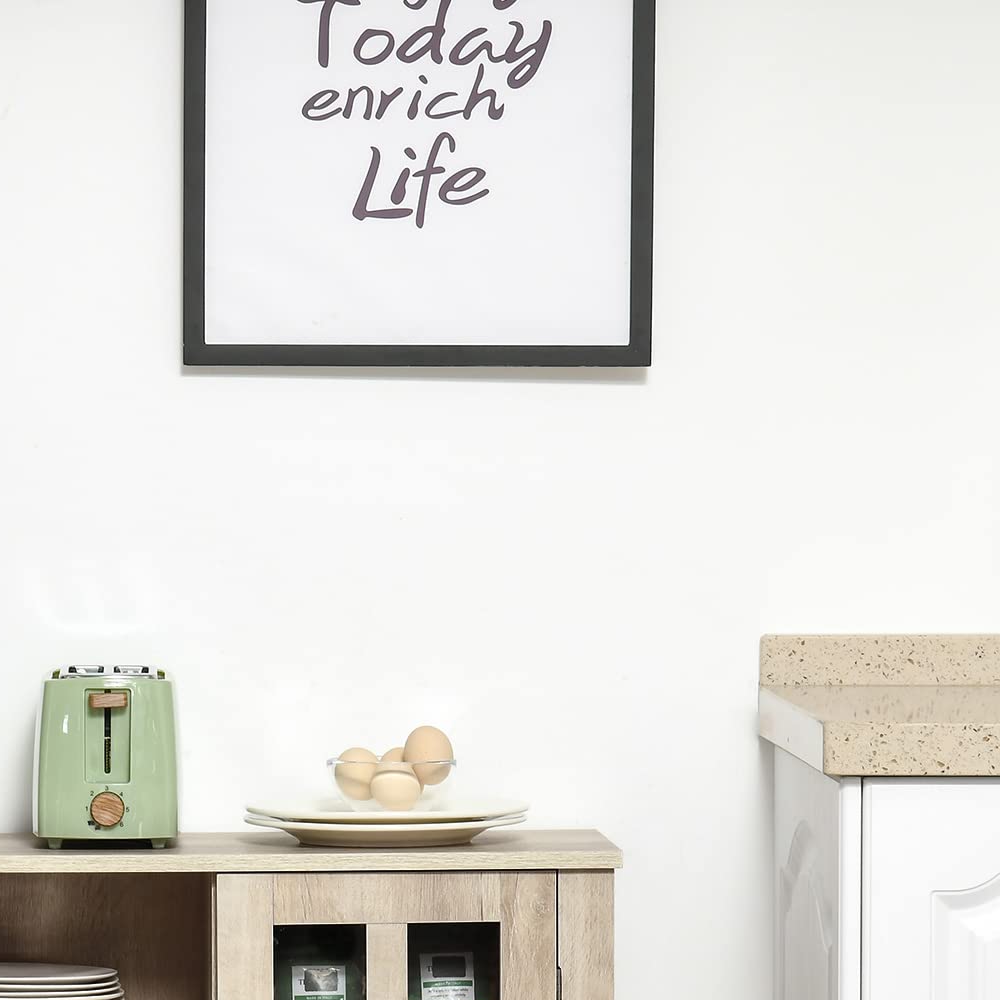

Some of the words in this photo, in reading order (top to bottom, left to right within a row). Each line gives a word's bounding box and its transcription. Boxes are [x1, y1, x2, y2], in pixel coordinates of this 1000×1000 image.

[298, 0, 552, 89] Today
[302, 63, 505, 121] enrich
[352, 132, 490, 228] Life
